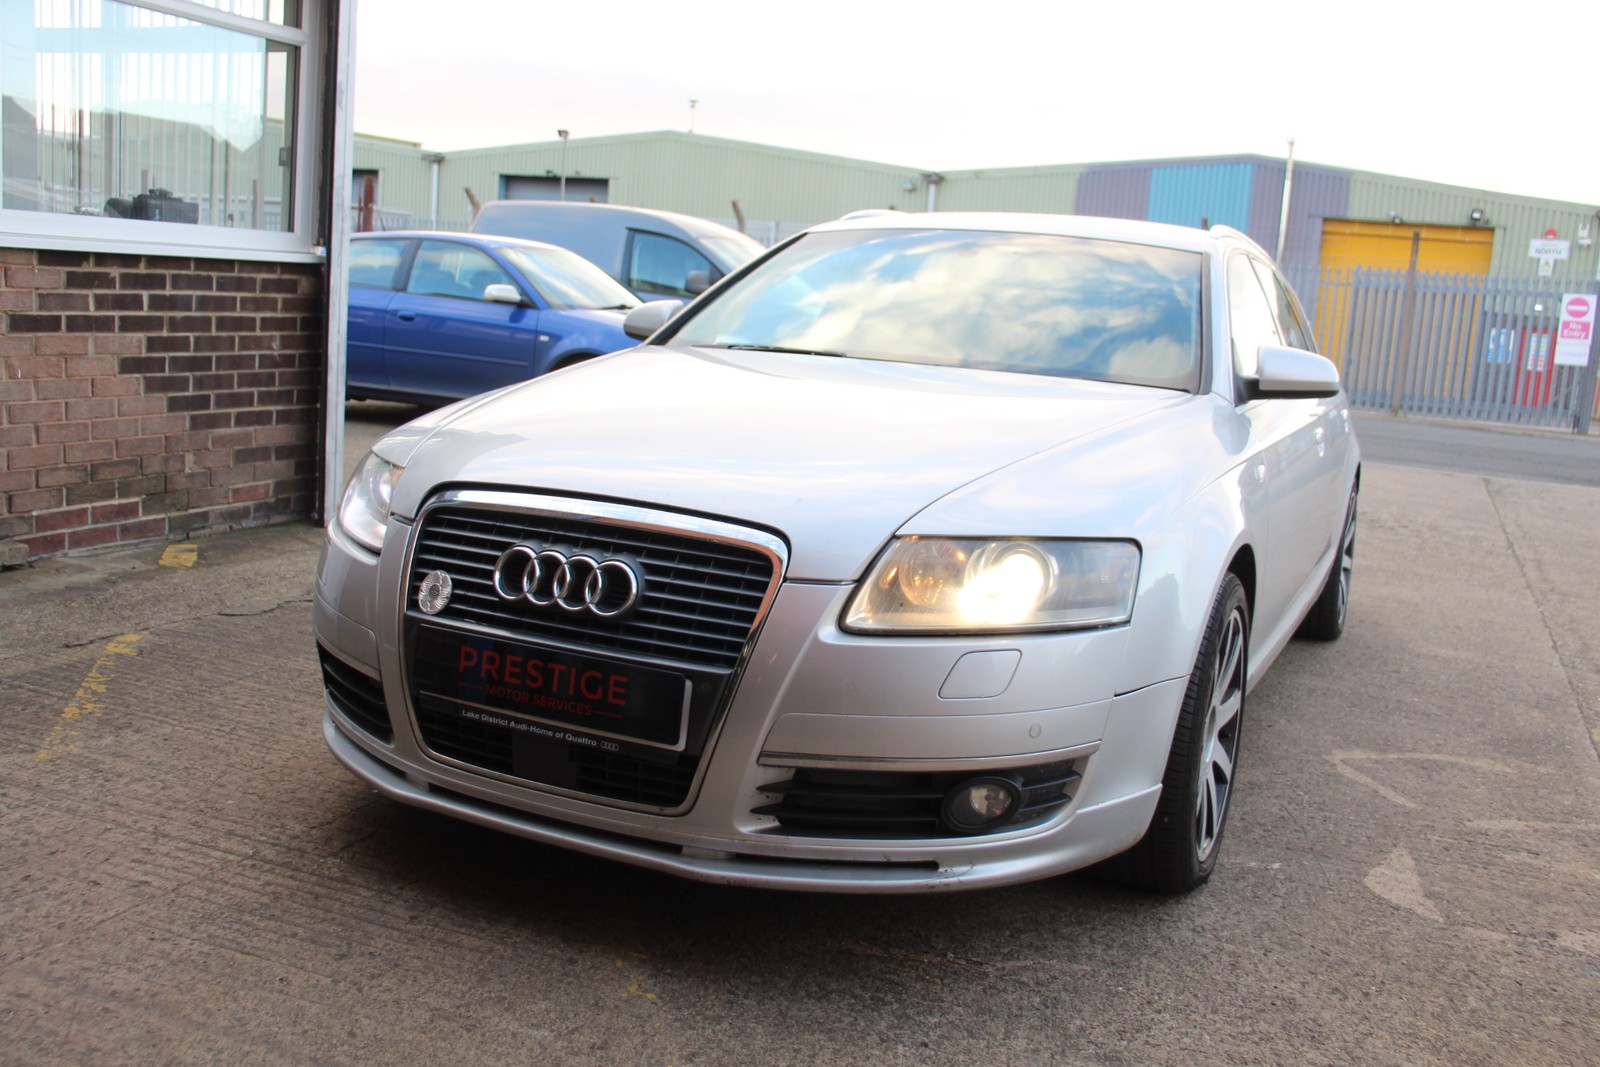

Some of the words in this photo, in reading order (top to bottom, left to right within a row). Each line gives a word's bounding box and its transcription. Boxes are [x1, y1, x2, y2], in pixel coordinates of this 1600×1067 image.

[1563, 329, 1586, 338] Entry
[1569, 321, 1582, 329] No
[458, 646, 629, 706] PRESTIGE
[485, 684, 529, 703] MOTOR
[533, 694, 593, 716] SERVICES
[462, 709, 480, 720] Lake
[481, 713, 508, 727] District
[509, 720, 554, 737] Audi-Home
[555, 731, 564, 739] of
[565, 733, 598, 746] Quattro
